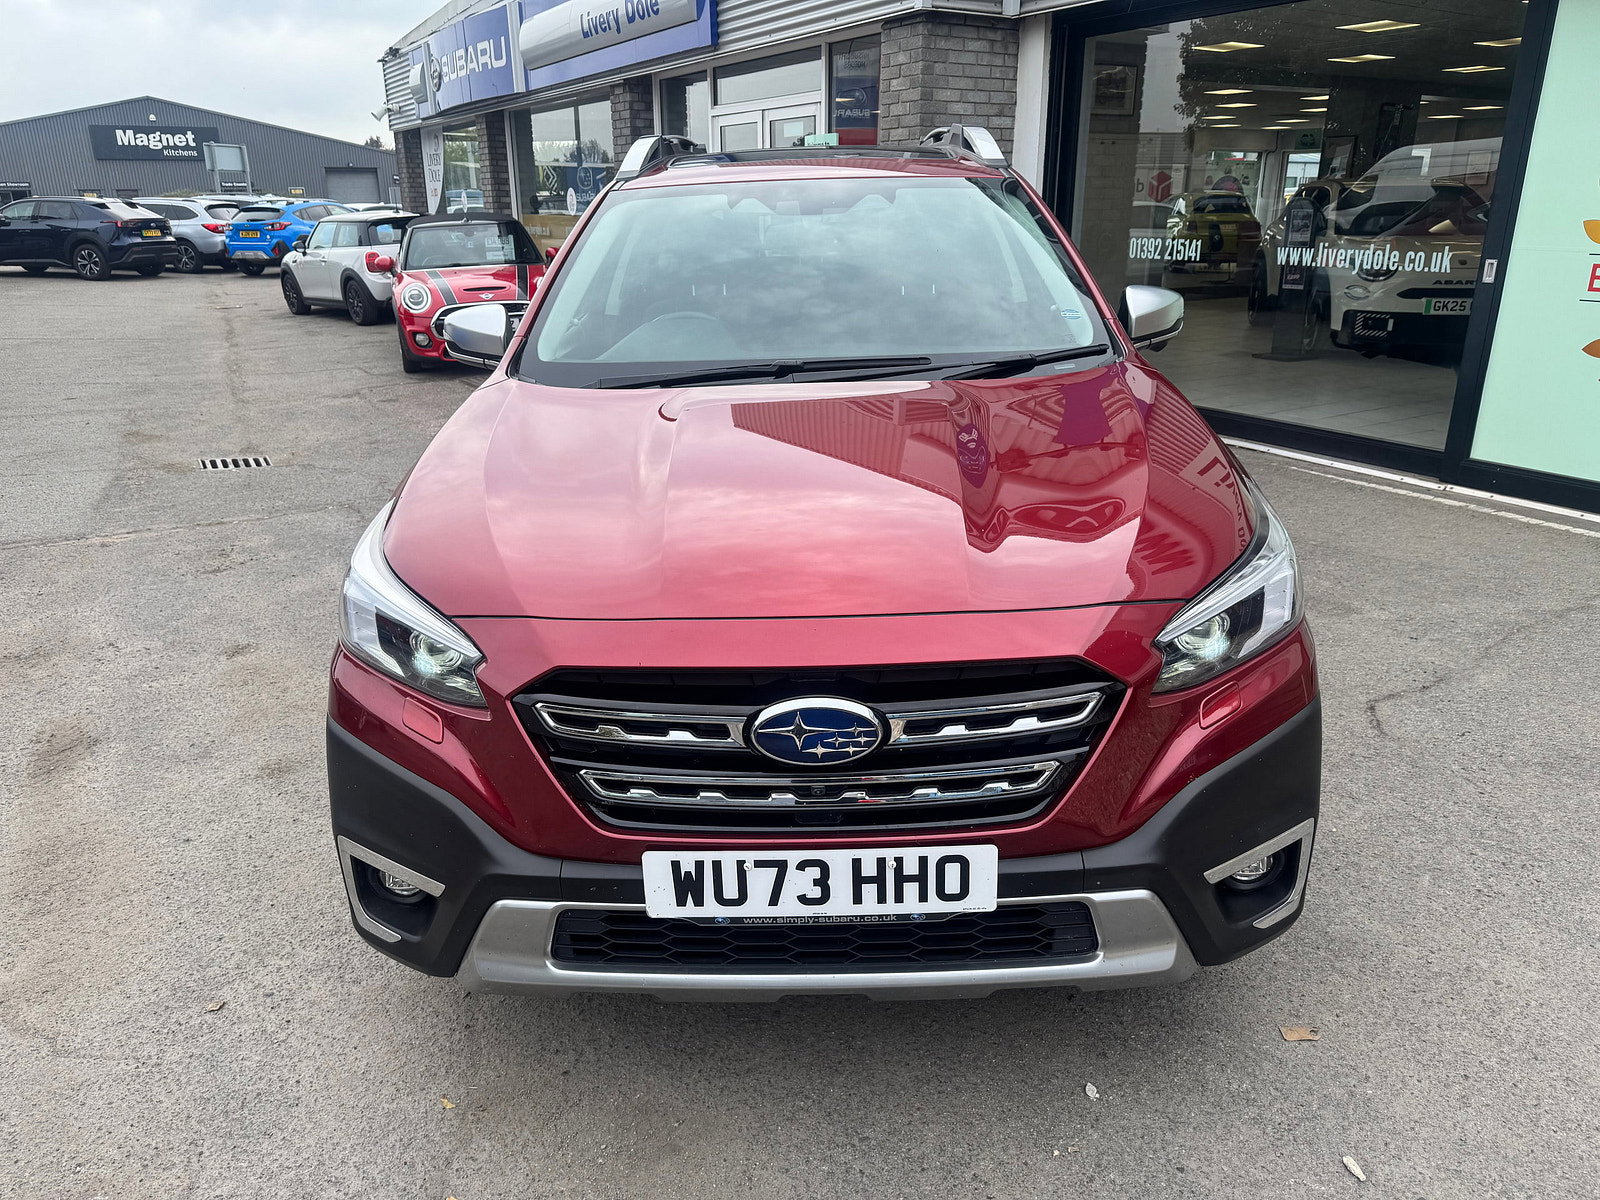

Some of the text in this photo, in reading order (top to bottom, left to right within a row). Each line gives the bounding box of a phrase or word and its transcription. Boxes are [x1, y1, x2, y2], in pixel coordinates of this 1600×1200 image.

[580, 0, 660, 39] Livery Dole
[441, 35, 507, 83] SUBARU
[115, 129, 197, 150] Magnet
[163, 148, 198, 157] Kitchens
[576, 192, 596, 202] SUBAR
[1129, 237, 1202, 261] 01392 215141
[1277, 242, 1452, 275] www.liverydole.co.uk
[1433, 300, 1467, 312] GK25
[670, 854, 970, 908] WU73 HHO
[743, 913, 897, 926] www.simply-subaru.co.uk
